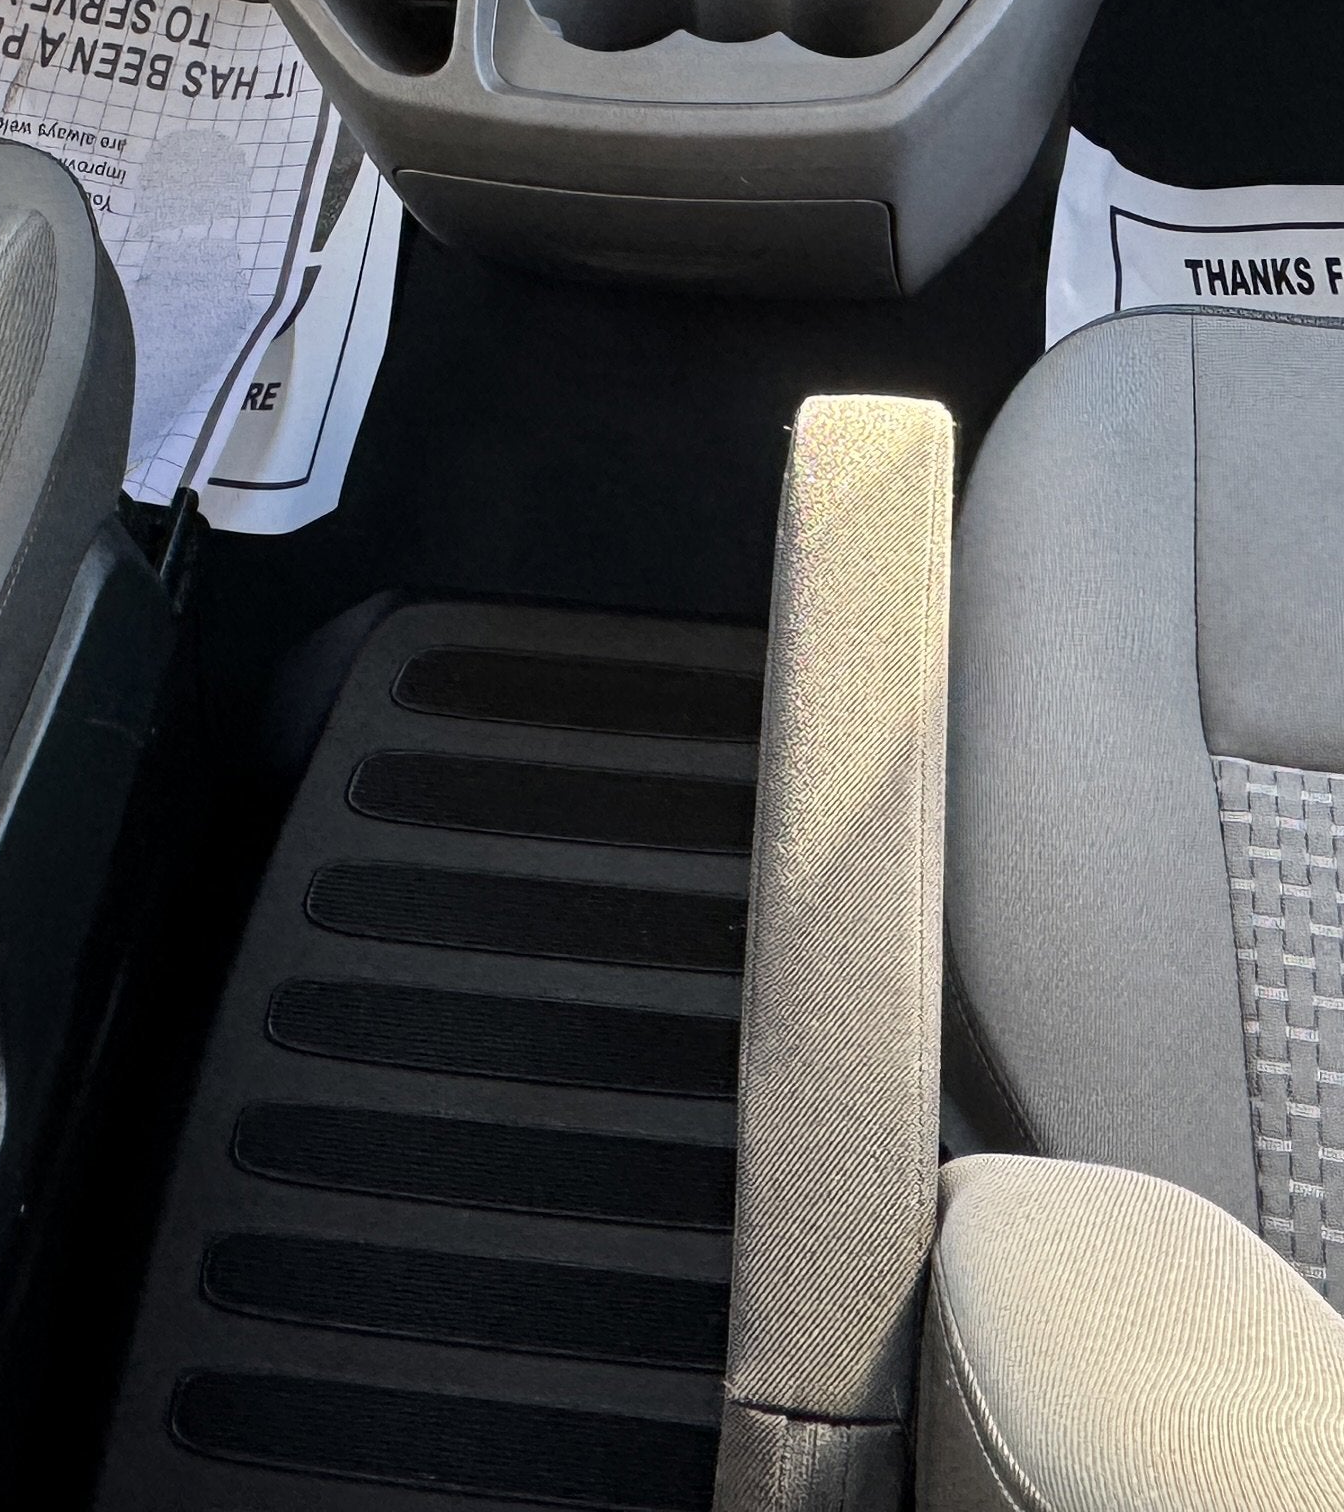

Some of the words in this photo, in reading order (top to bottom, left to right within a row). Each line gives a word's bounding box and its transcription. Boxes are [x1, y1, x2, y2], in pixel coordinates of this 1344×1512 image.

[165, 5, 211, 49] TO
[40, 27, 67, 68] A
[69, 37, 173, 91] BEEN
[182, 60, 259, 101] HAS
[264, 60, 298, 100] IT
[38, 122, 97, 147] always
[1184, 256, 1315, 296] THANKS
[241, 382, 282, 411] RE
